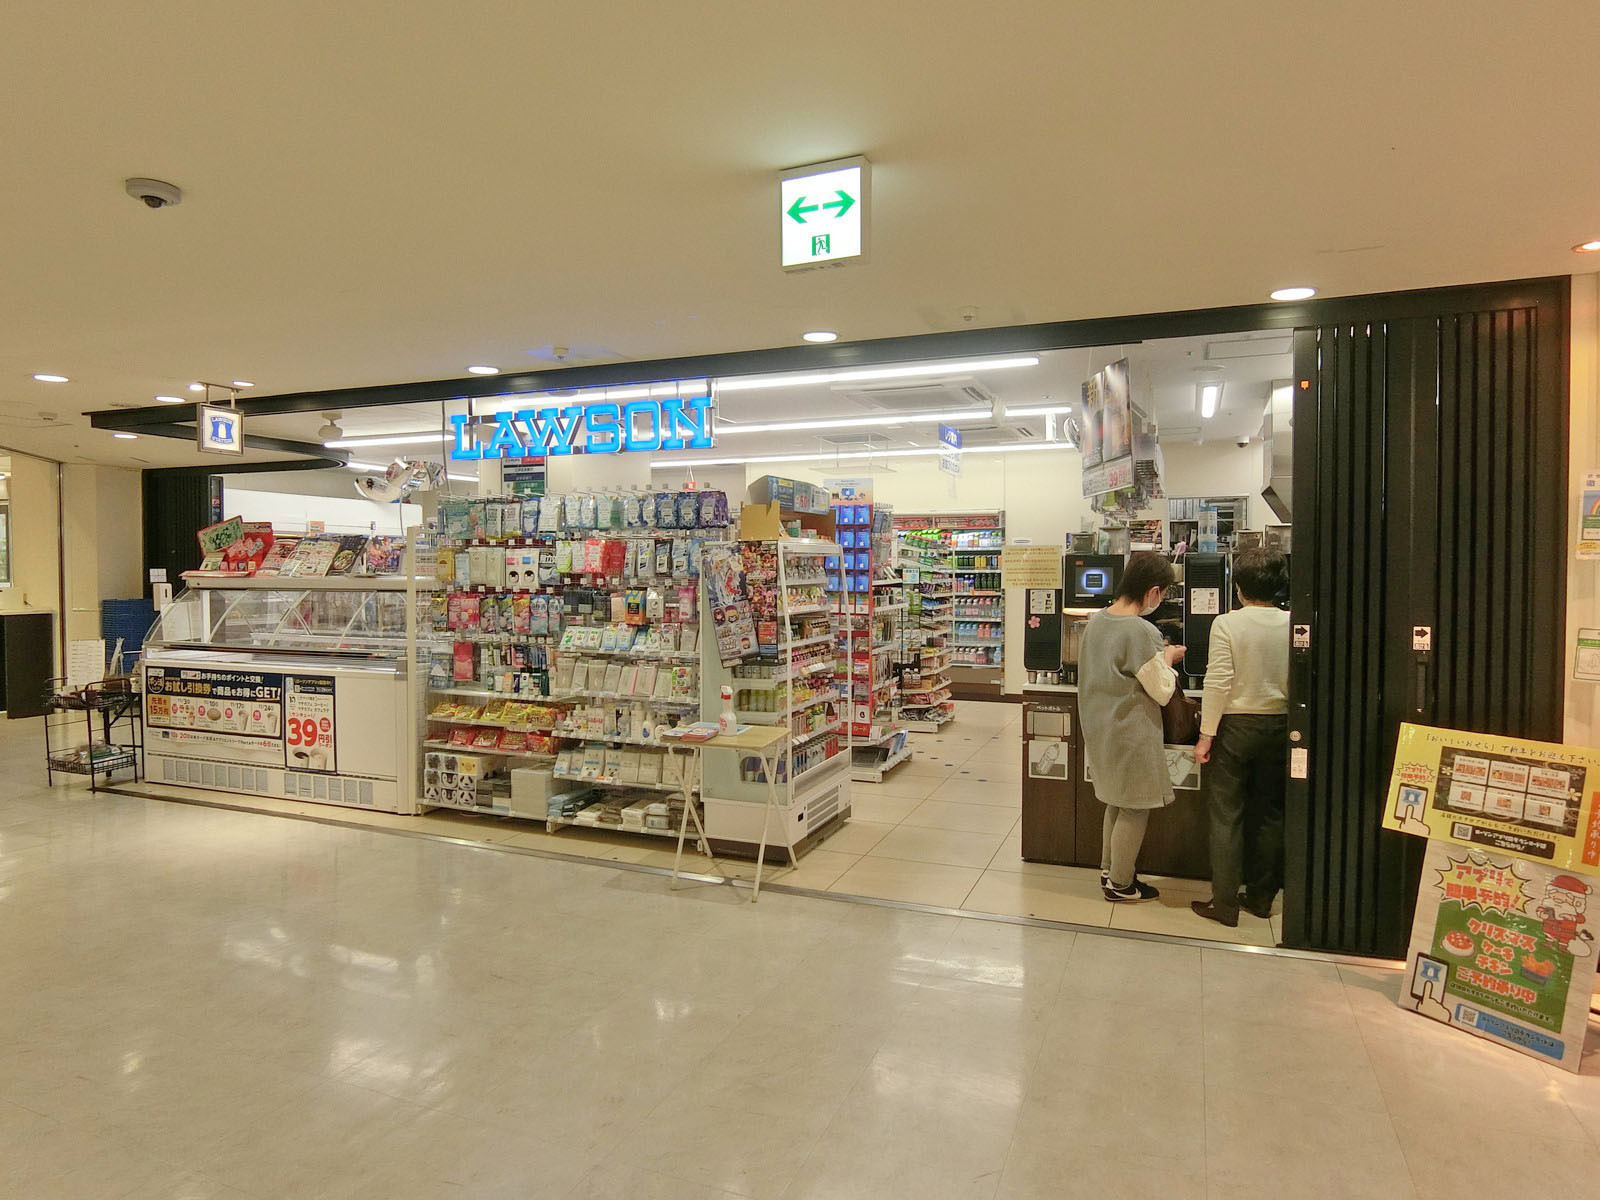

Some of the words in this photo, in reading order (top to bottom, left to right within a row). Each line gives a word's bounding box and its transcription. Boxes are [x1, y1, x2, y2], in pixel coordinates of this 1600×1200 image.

[450, 396, 714, 460] LAWSON
[288, 717, 318, 747] 39
[1467, 917, 1538, 952] クリスマス
[1475, 954, 1514, 976] チキン
[1480, 940, 1515, 961] ケーキ
